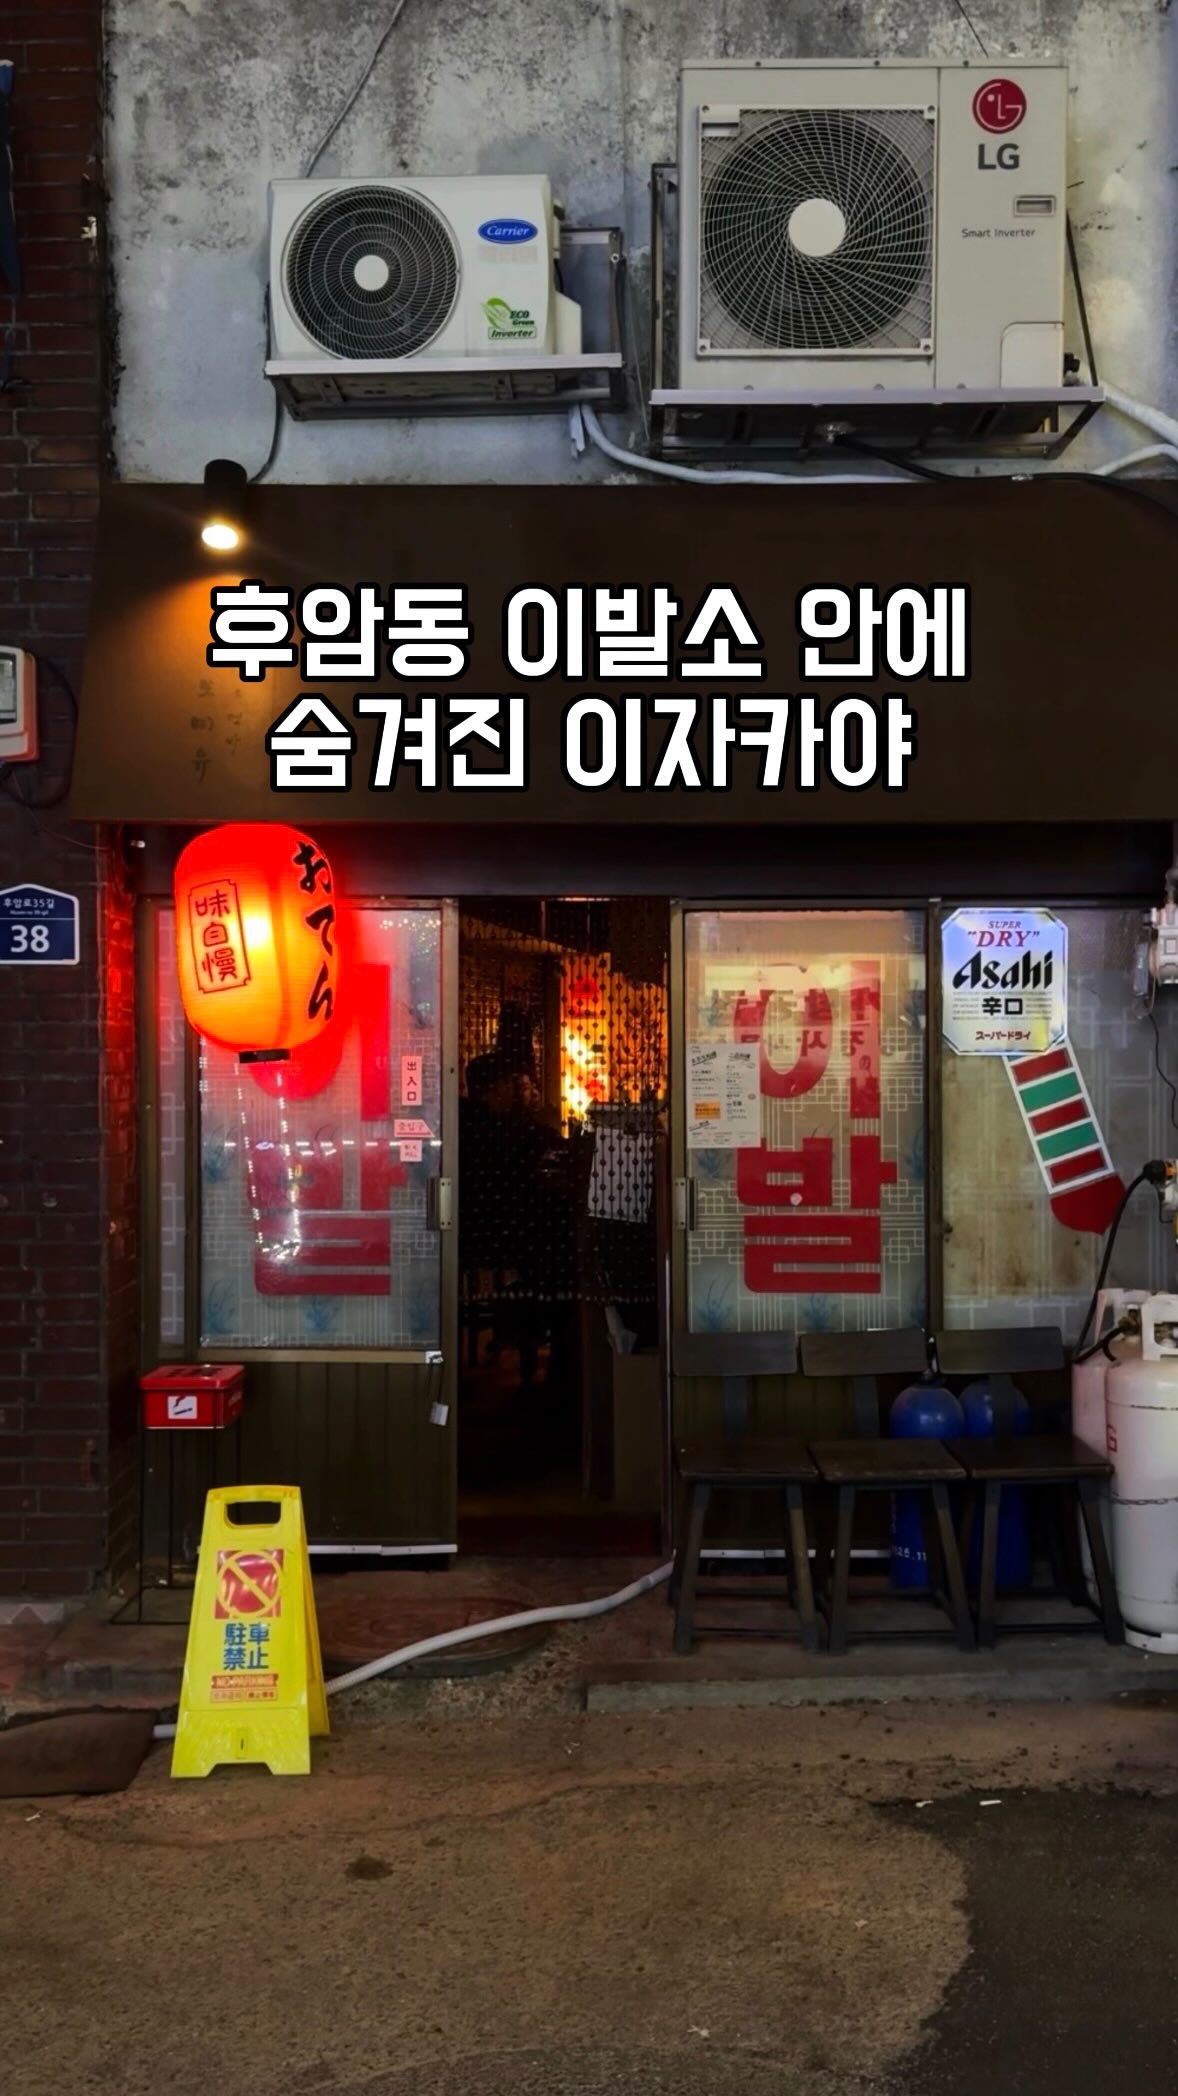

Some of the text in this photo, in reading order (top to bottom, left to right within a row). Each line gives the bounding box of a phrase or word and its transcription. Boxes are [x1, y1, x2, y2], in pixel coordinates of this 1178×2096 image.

[977, 143, 1020, 170] LG
[486, 225, 530, 236] Carrier
[961, 228, 1036, 238] Smart Inverter
[509, 310, 530, 319] ECO
[491, 326, 534, 338] Inverter
[194, 889, 238, 983] 味自慢
[988, 920, 1022, 929] SUPER
[10, 924, 50, 953] 38
[952, 949, 1053, 990] Asahi
[982, 996, 1023, 1016] 辛口
[975, 1031, 1031, 1041] スーパードライ
[407, 1061, 417, 1101] 出入口
[733, 960, 898, 1294] 이발
[223, 1622, 271, 1646] 駐車
[223, 1645, 270, 1671] 禁止
